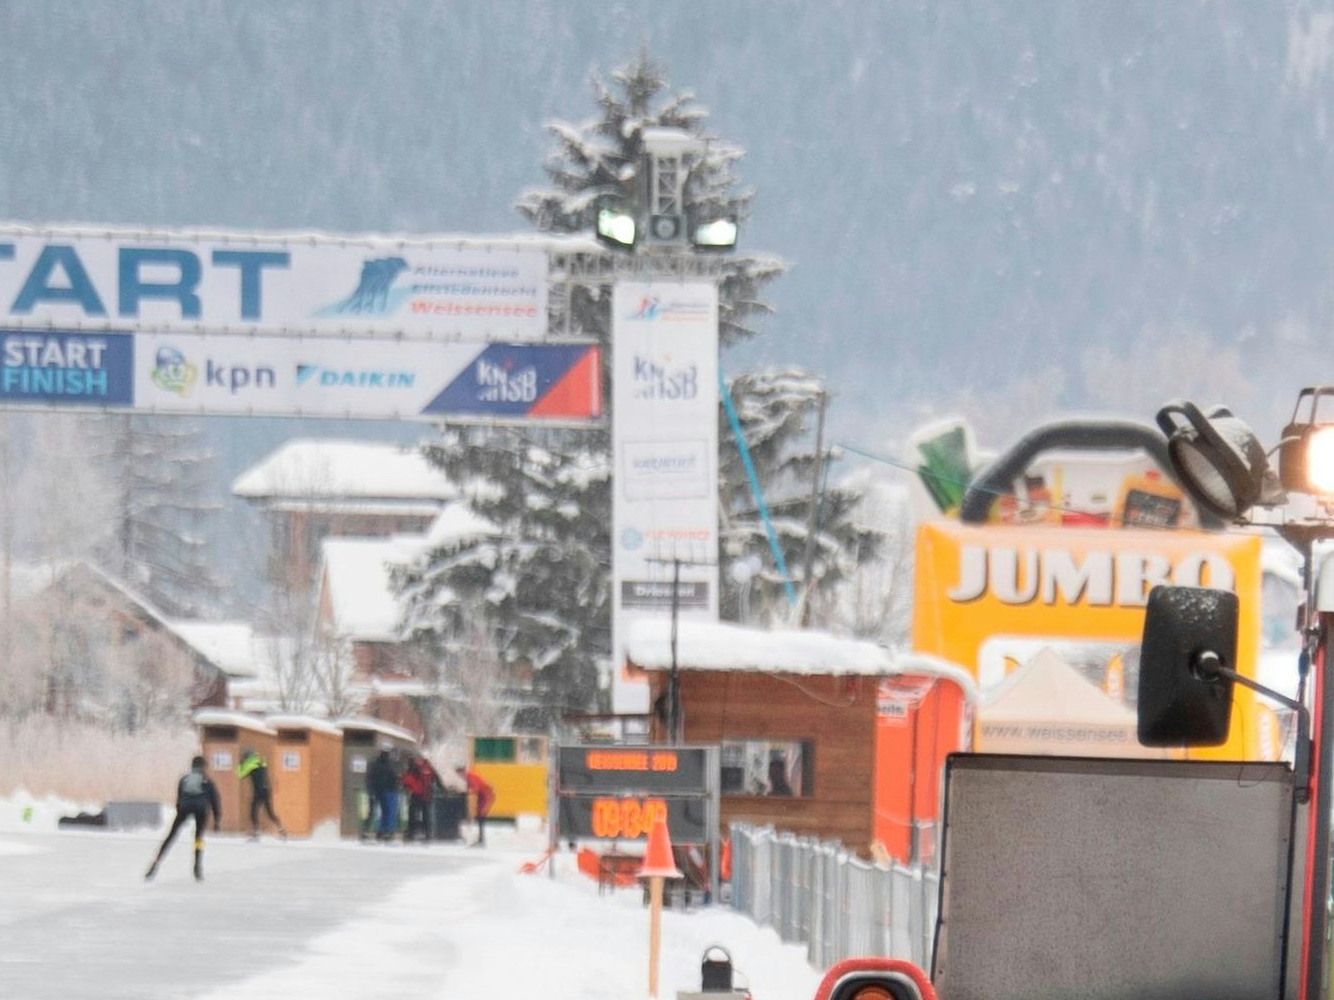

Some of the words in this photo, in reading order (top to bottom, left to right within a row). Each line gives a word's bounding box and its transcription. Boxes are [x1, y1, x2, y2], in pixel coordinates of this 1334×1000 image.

[411, 302, 538, 318] Weissensee
[2, 337, 105, 368] START
[2, 366, 107, 396] FINISH
[207, 357, 276, 390] kpn
[319, 369, 416, 389] DAIKIN
[948, 546, 1235, 609] JUMBO
